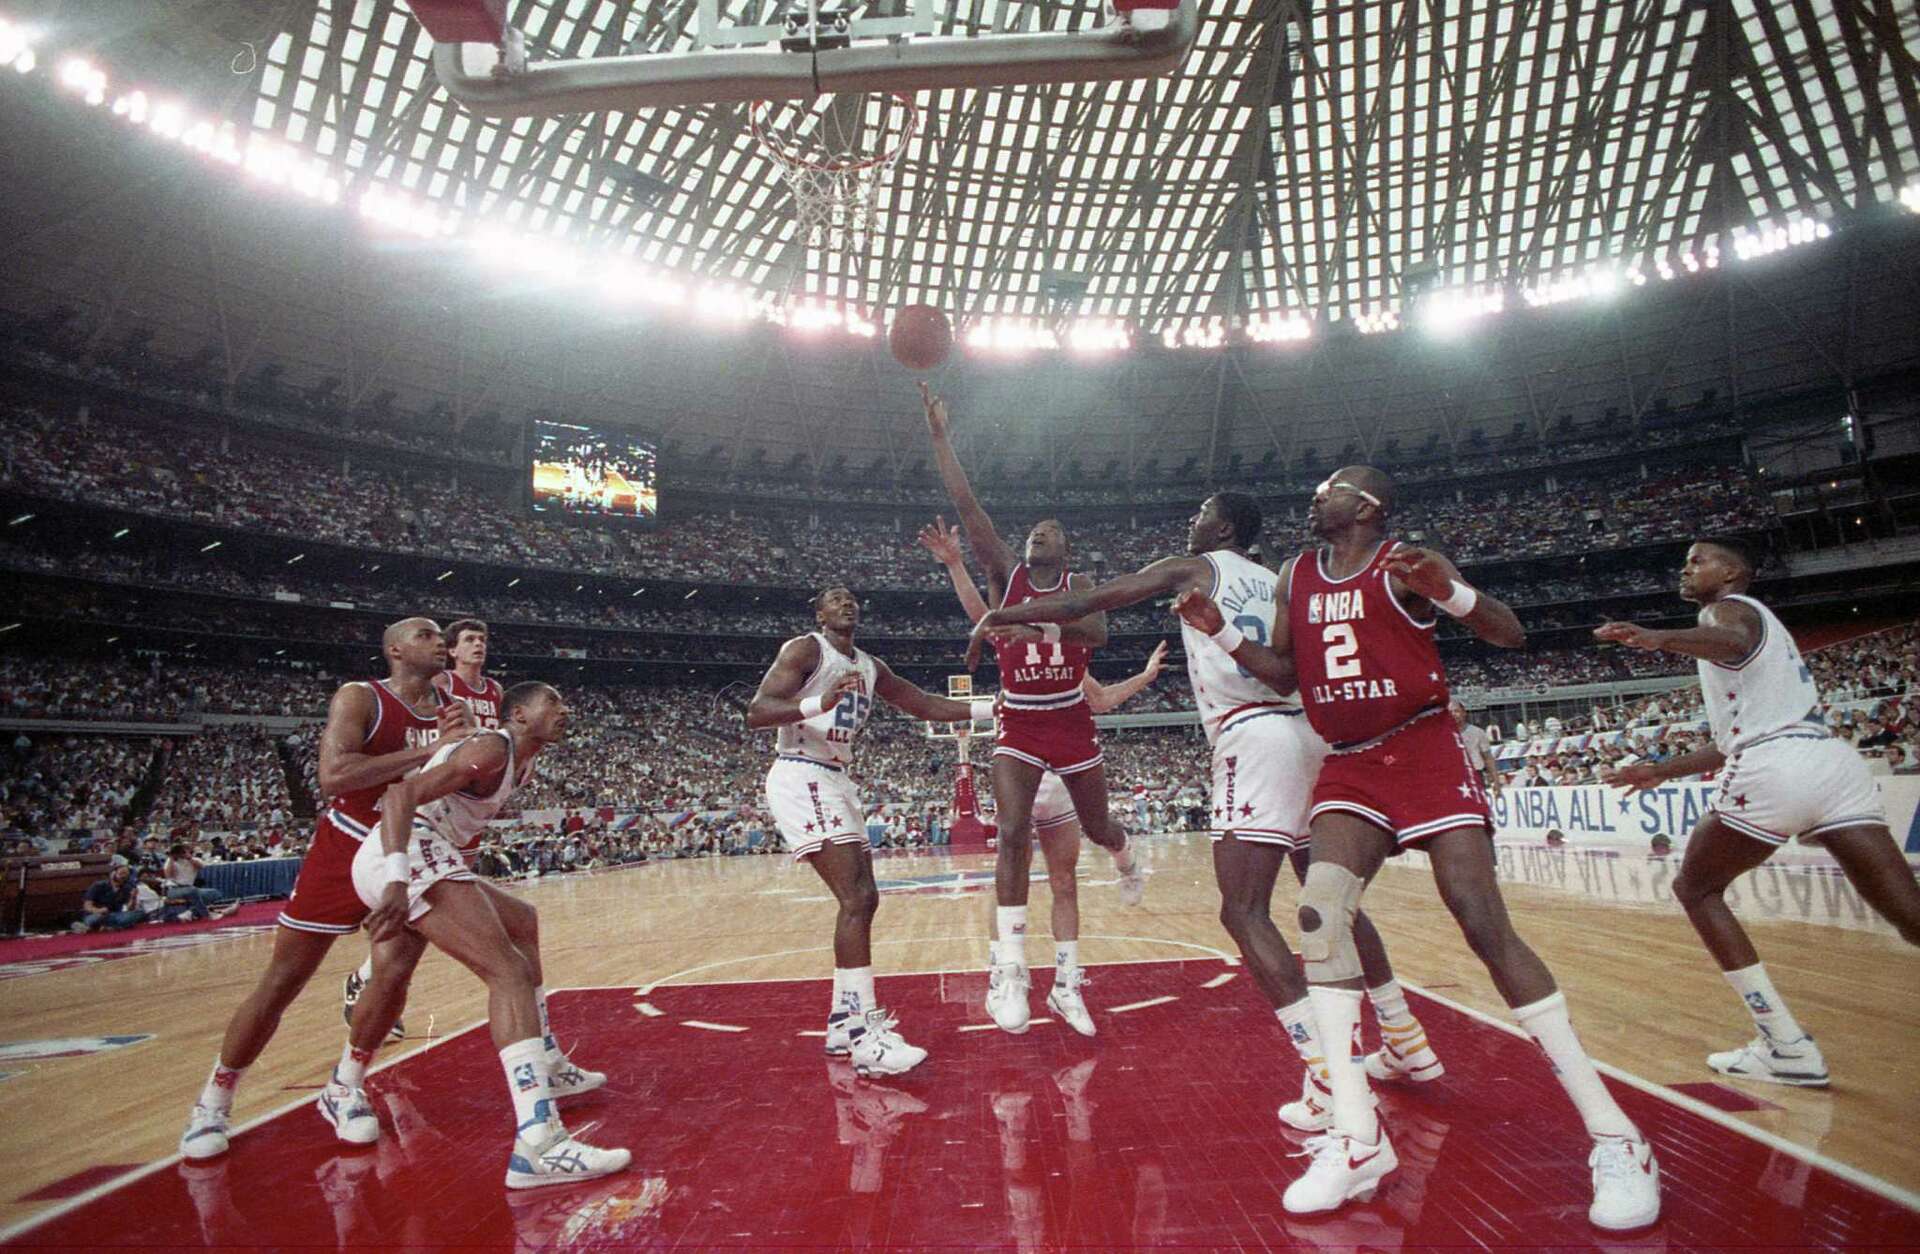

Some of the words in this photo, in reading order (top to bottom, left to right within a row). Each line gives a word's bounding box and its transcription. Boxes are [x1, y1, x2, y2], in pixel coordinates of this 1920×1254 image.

[1325, 589, 1364, 622] NBA
[1323, 623, 1362, 680] 2
[807, 781, 827, 833] WEST
[1514, 789, 1562, 829] NBA
[1569, 789, 1616, 832] ALL
